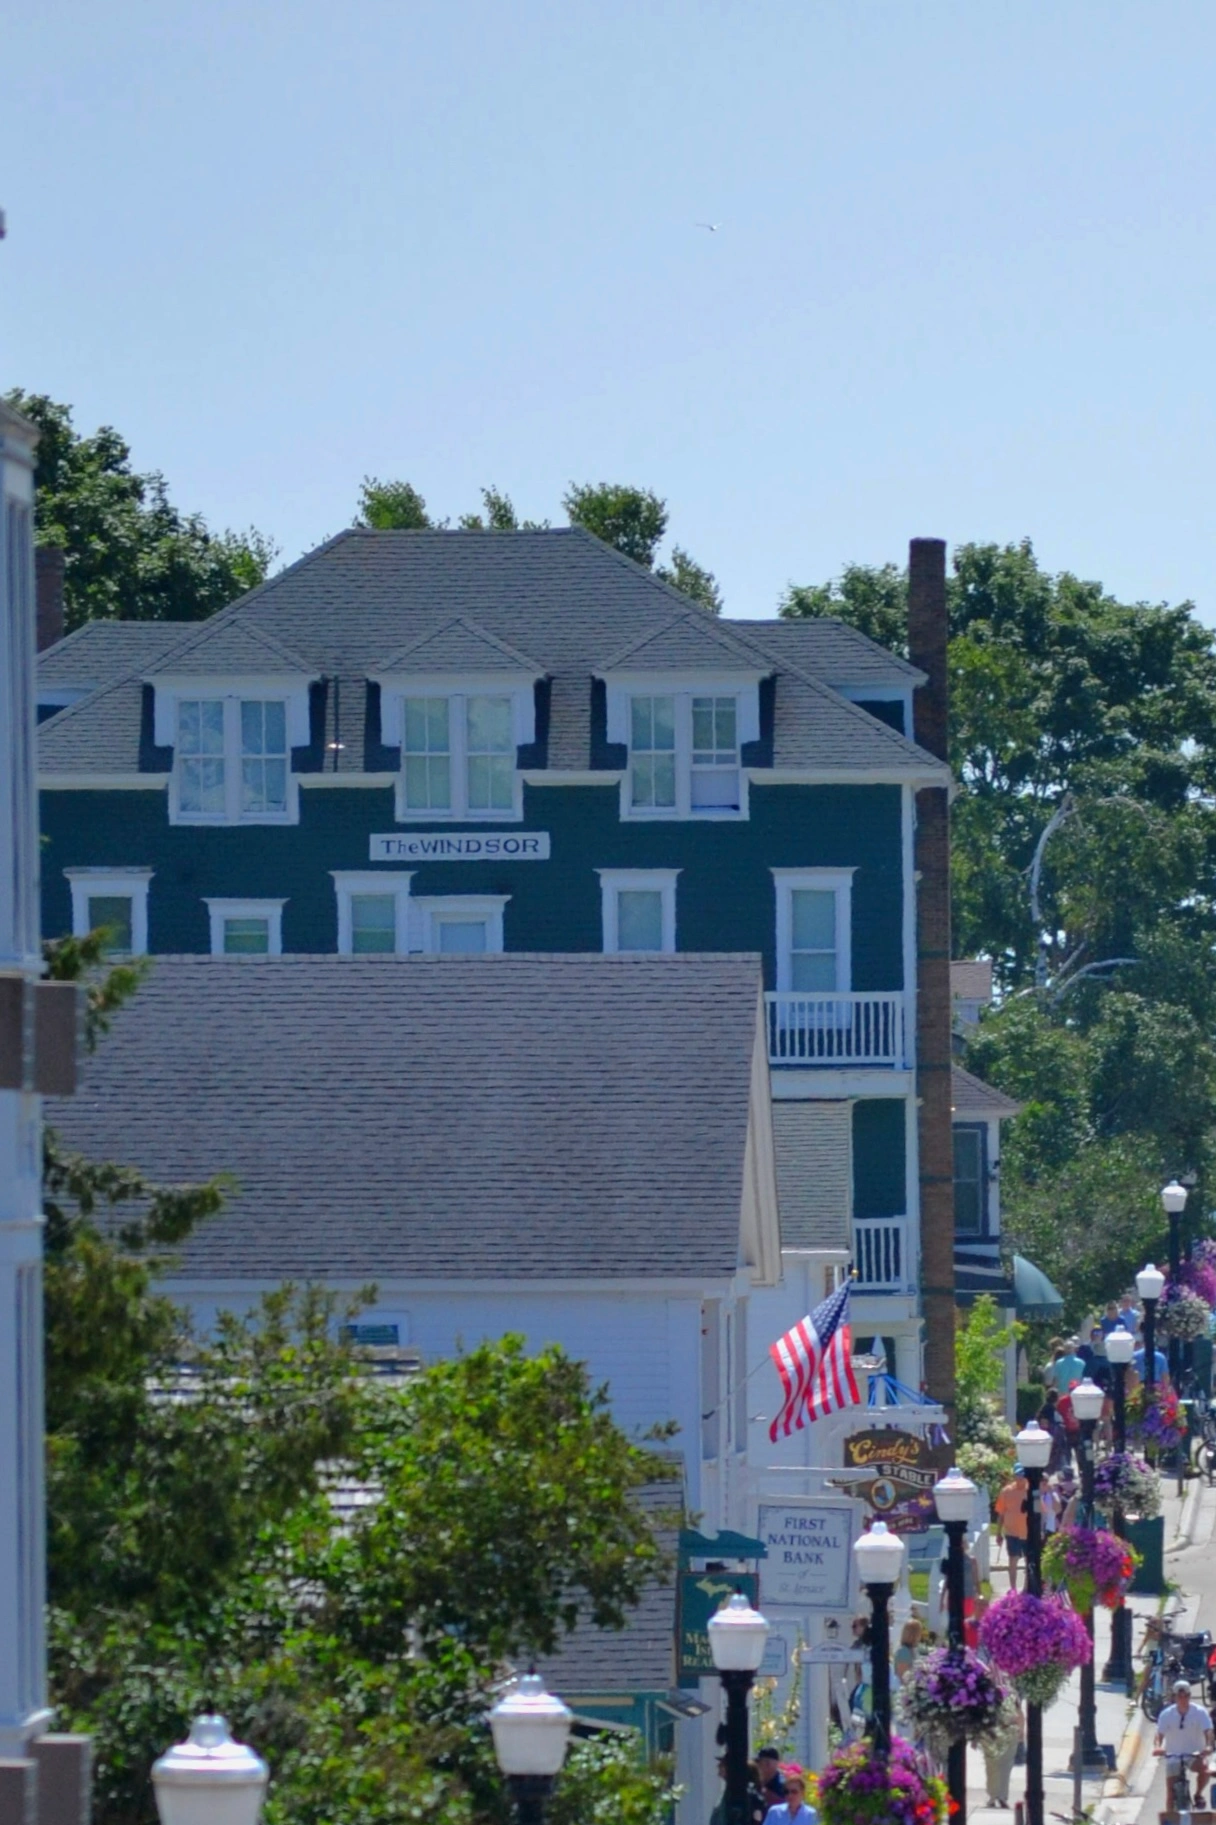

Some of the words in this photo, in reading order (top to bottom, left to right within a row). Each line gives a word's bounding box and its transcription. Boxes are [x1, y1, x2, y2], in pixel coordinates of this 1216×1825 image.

[420, 838, 540, 854] WINDSOR
[848, 1439, 920, 1465] Cindy's
[882, 1464, 933, 1486] STABLE
[784, 1516, 827, 1531] FIRST
[767, 1533, 841, 1549] NATIONAL
[783, 1550, 824, 1565] BANK
